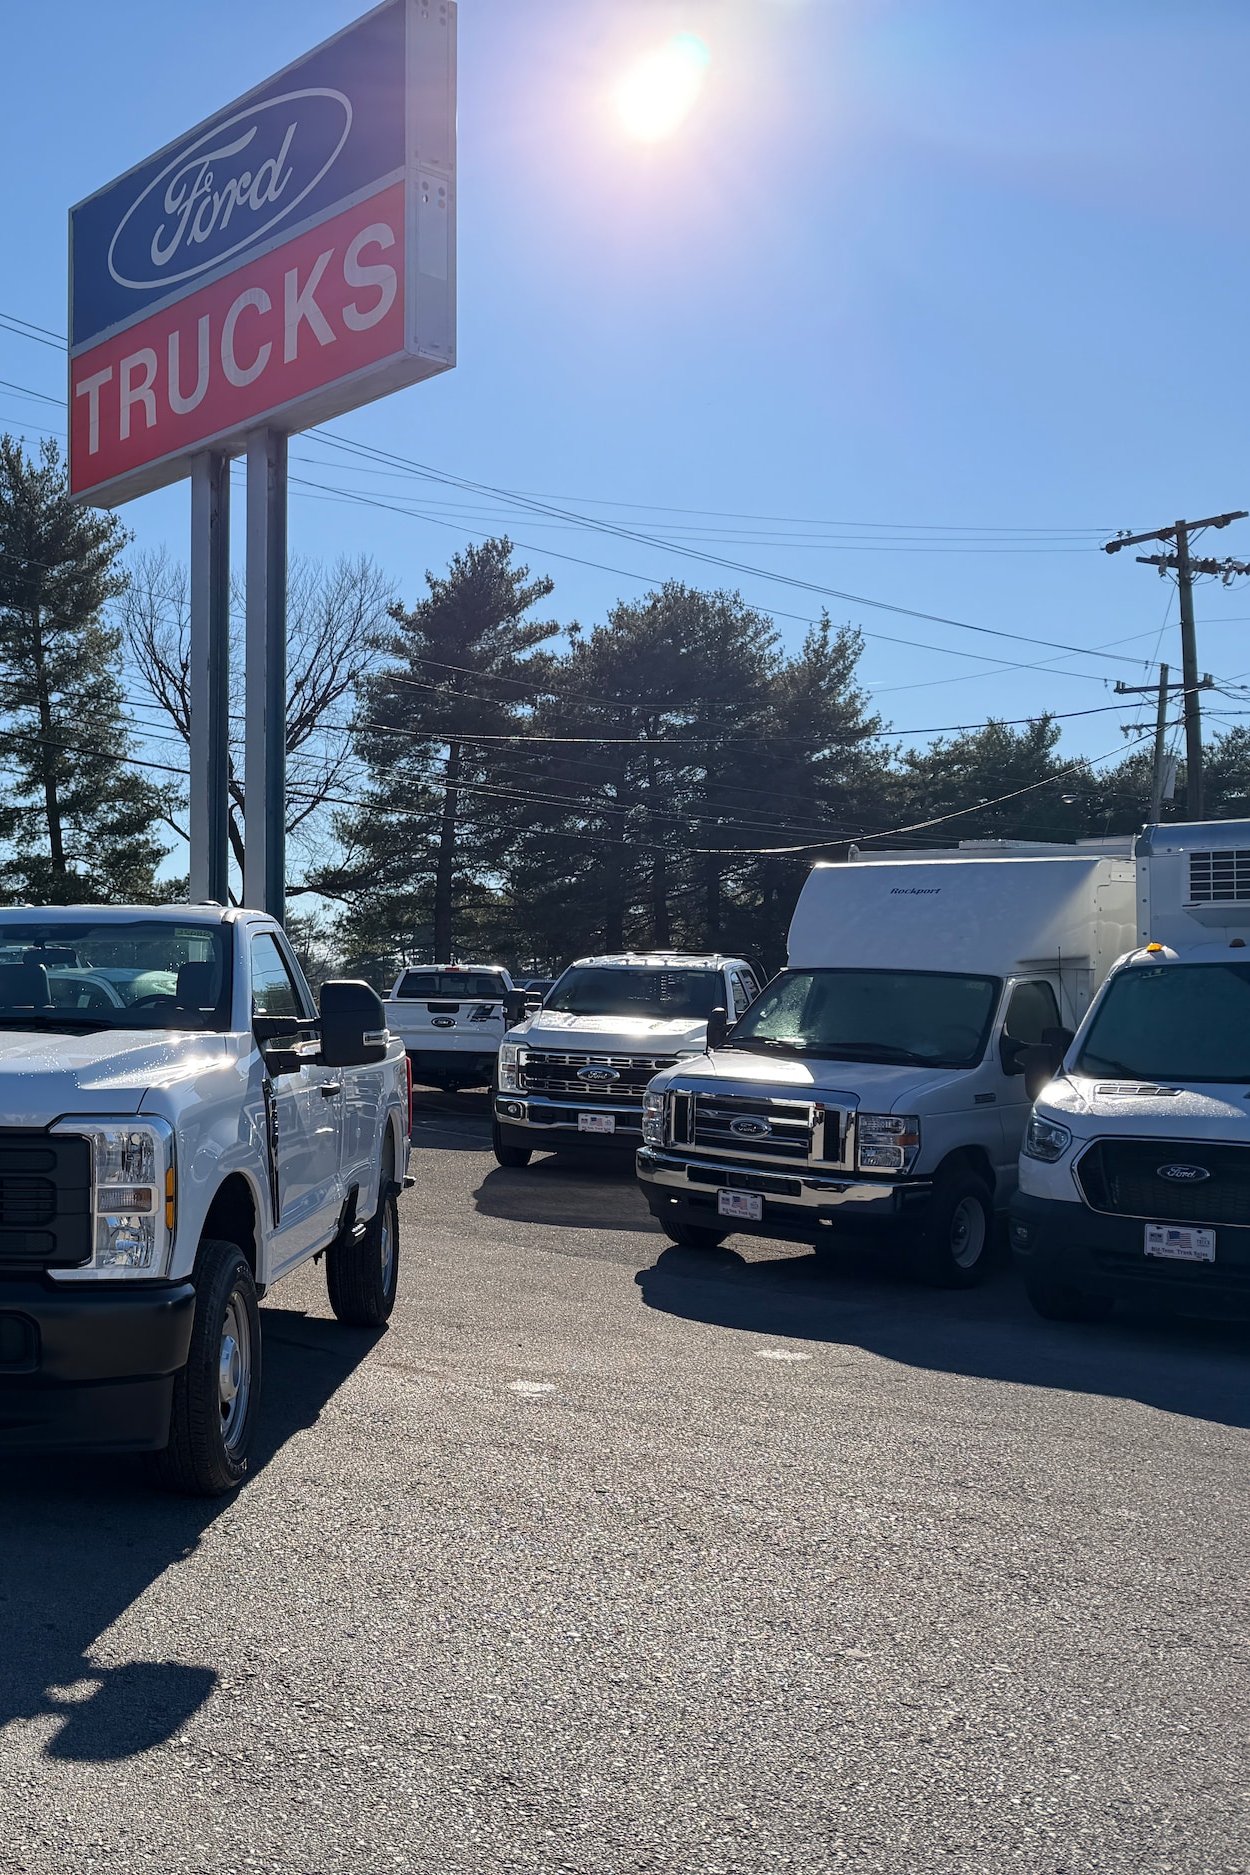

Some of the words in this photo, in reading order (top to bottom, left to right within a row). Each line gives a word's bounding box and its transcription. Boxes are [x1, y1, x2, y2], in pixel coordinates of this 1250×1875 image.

[150, 121, 298, 266] Ford
[75, 222, 398, 455] TRUCKS
[890, 887, 942, 896] Rockport
[587, 1070, 608, 1079] Ford
[1166, 1166, 1197, 1178] Ford
